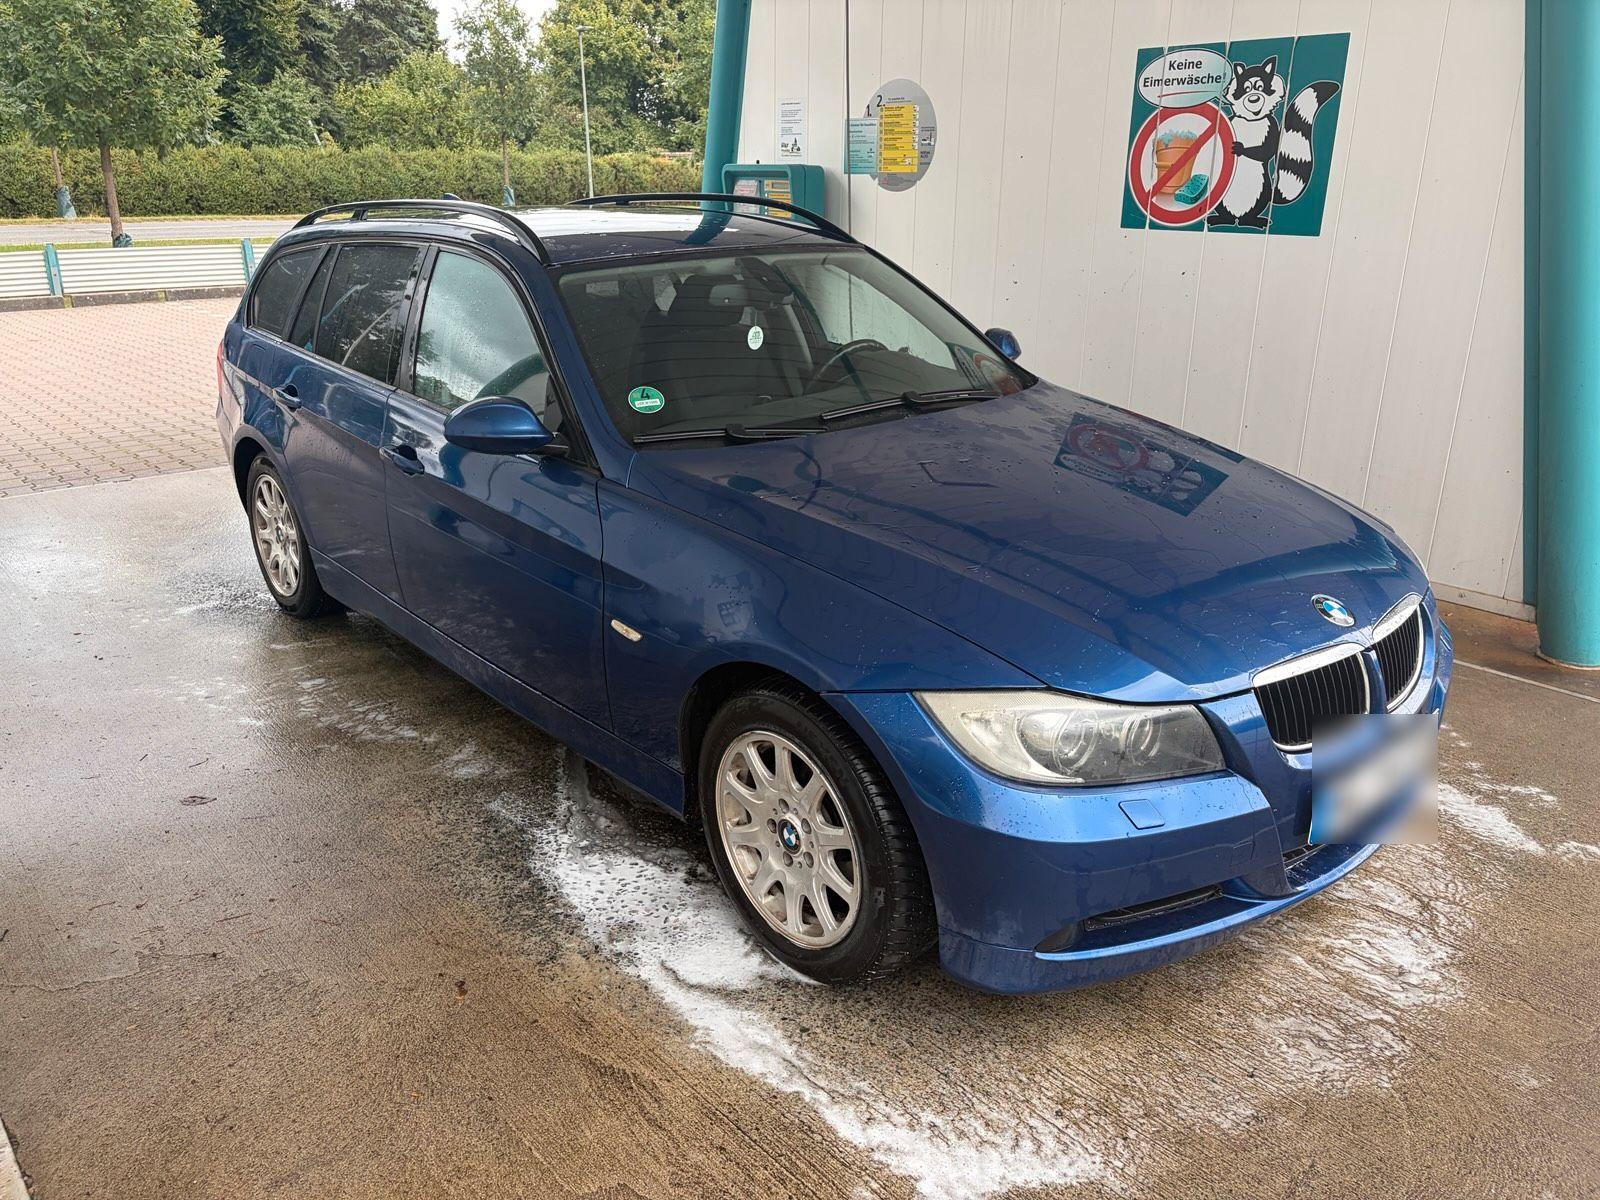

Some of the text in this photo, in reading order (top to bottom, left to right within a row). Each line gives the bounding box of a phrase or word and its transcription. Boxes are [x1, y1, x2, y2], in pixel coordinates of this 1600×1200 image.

[1168, 59, 1203, 71] Keine
[1143, 73, 1226, 87] Eimerwäsche!
[640, 388, 650, 400] 4
